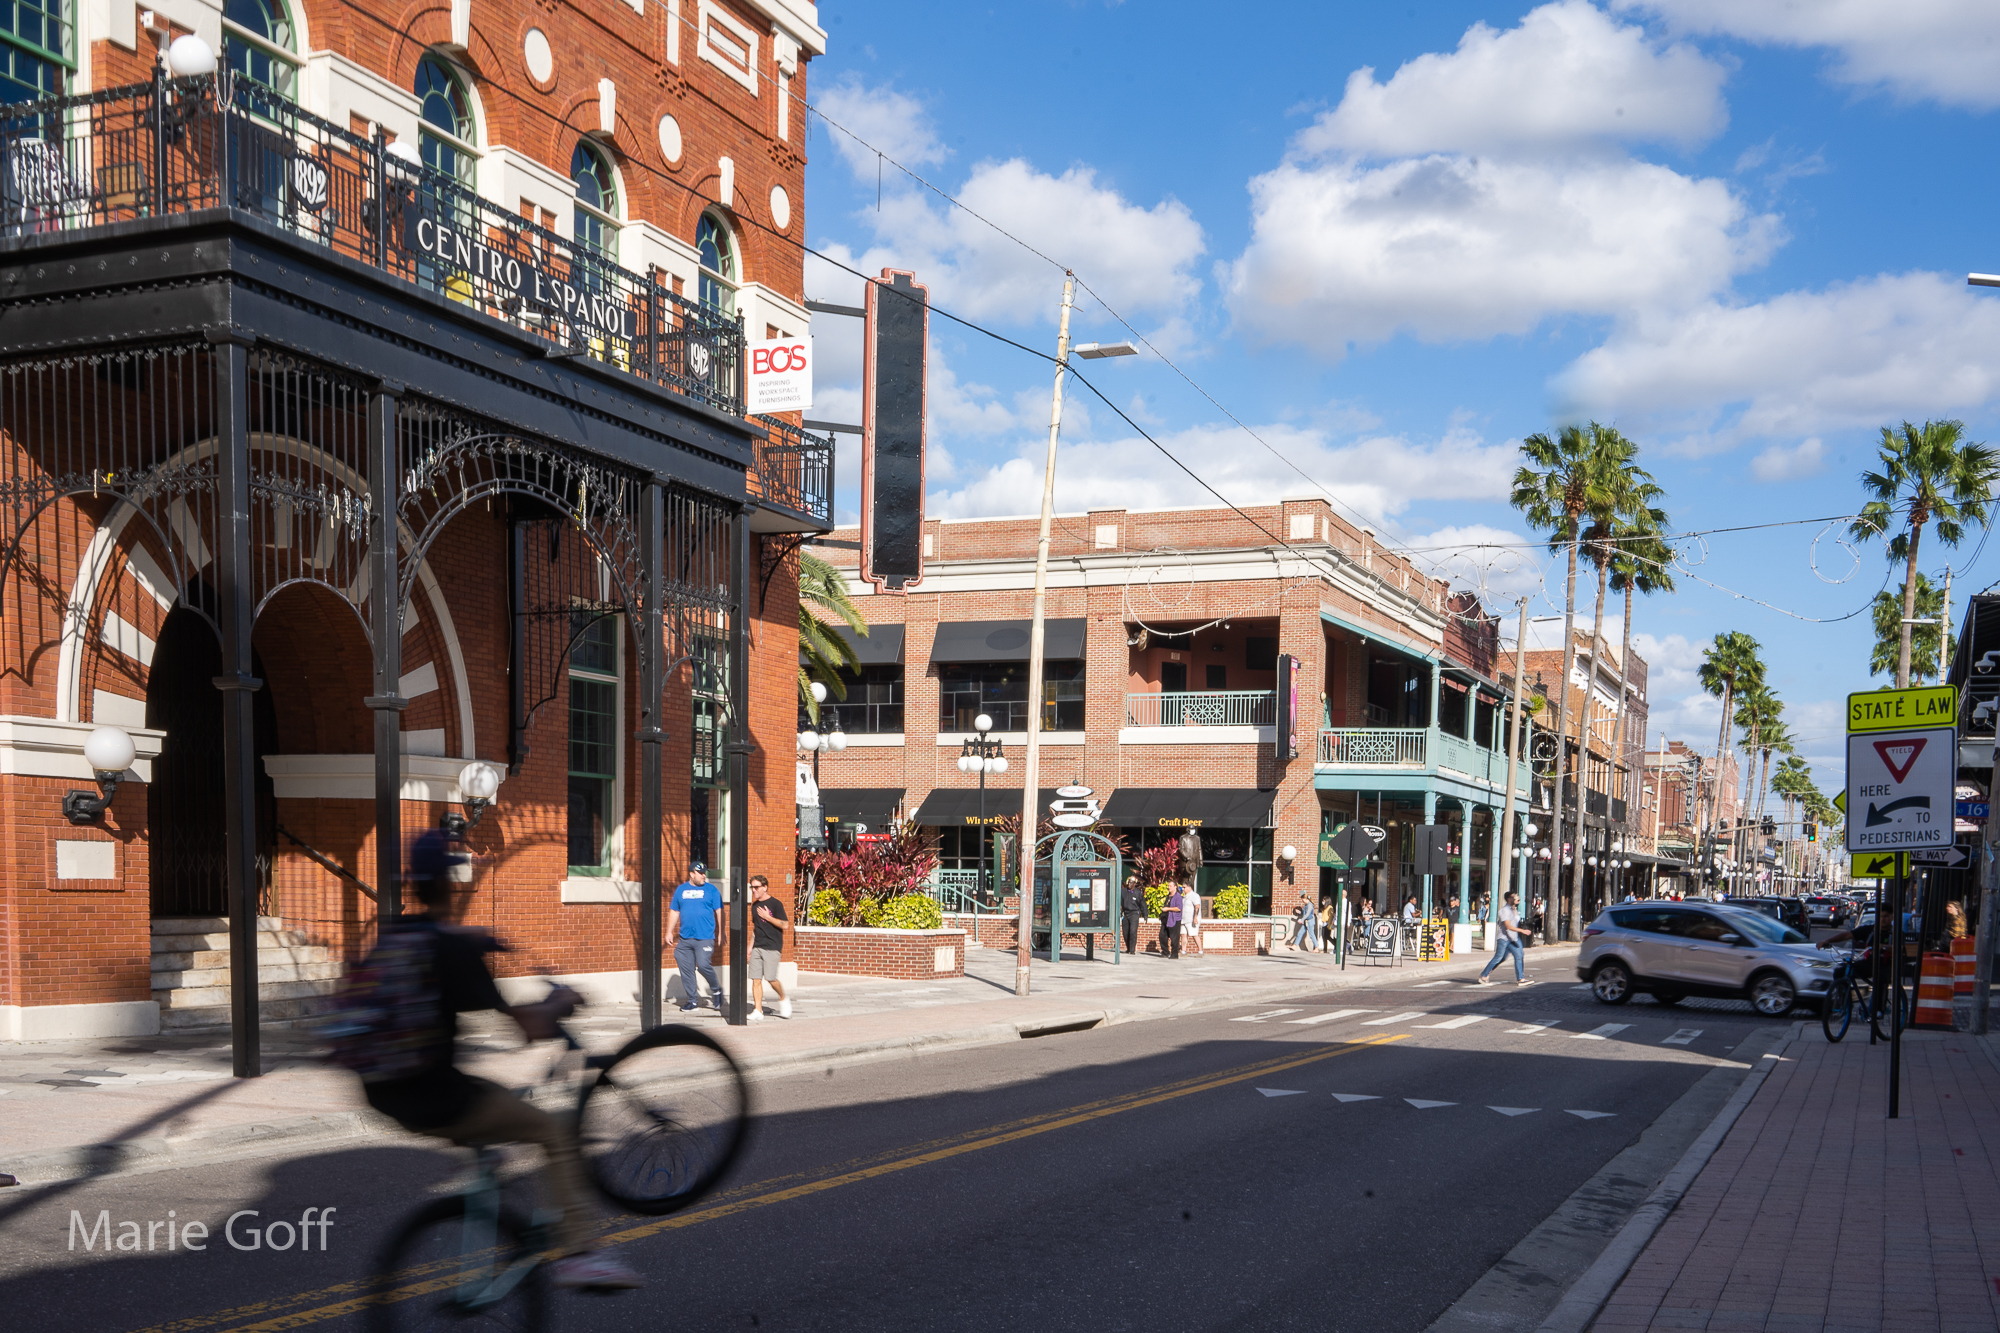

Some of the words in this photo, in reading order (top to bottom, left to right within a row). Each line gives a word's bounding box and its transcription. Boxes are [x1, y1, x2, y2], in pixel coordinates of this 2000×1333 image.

[294, 158, 327, 204] 1892
[417, 218, 522, 290] CENTRO
[534, 269, 633, 341] ESPAÑOL
[690, 343, 709, 376] 1912
[753, 345, 807, 374] BOS
[758, 387, 799, 396] WORKSPACE
[758, 395, 801, 404] FURNISHINGS
[1852, 700, 1905, 721] STATE
[1915, 697, 1951, 716] LAW
[1860, 784, 1891, 797] HERE
[1158, 817, 1180, 827] Craft
[1182, 817, 1203, 827] Beer
[1916, 812, 1931, 823] TO
[1860, 829, 1941, 845] PEDESTRIANS
[1909, 850, 1923, 859] NE
[1926, 851, 1947, 860] WAY
